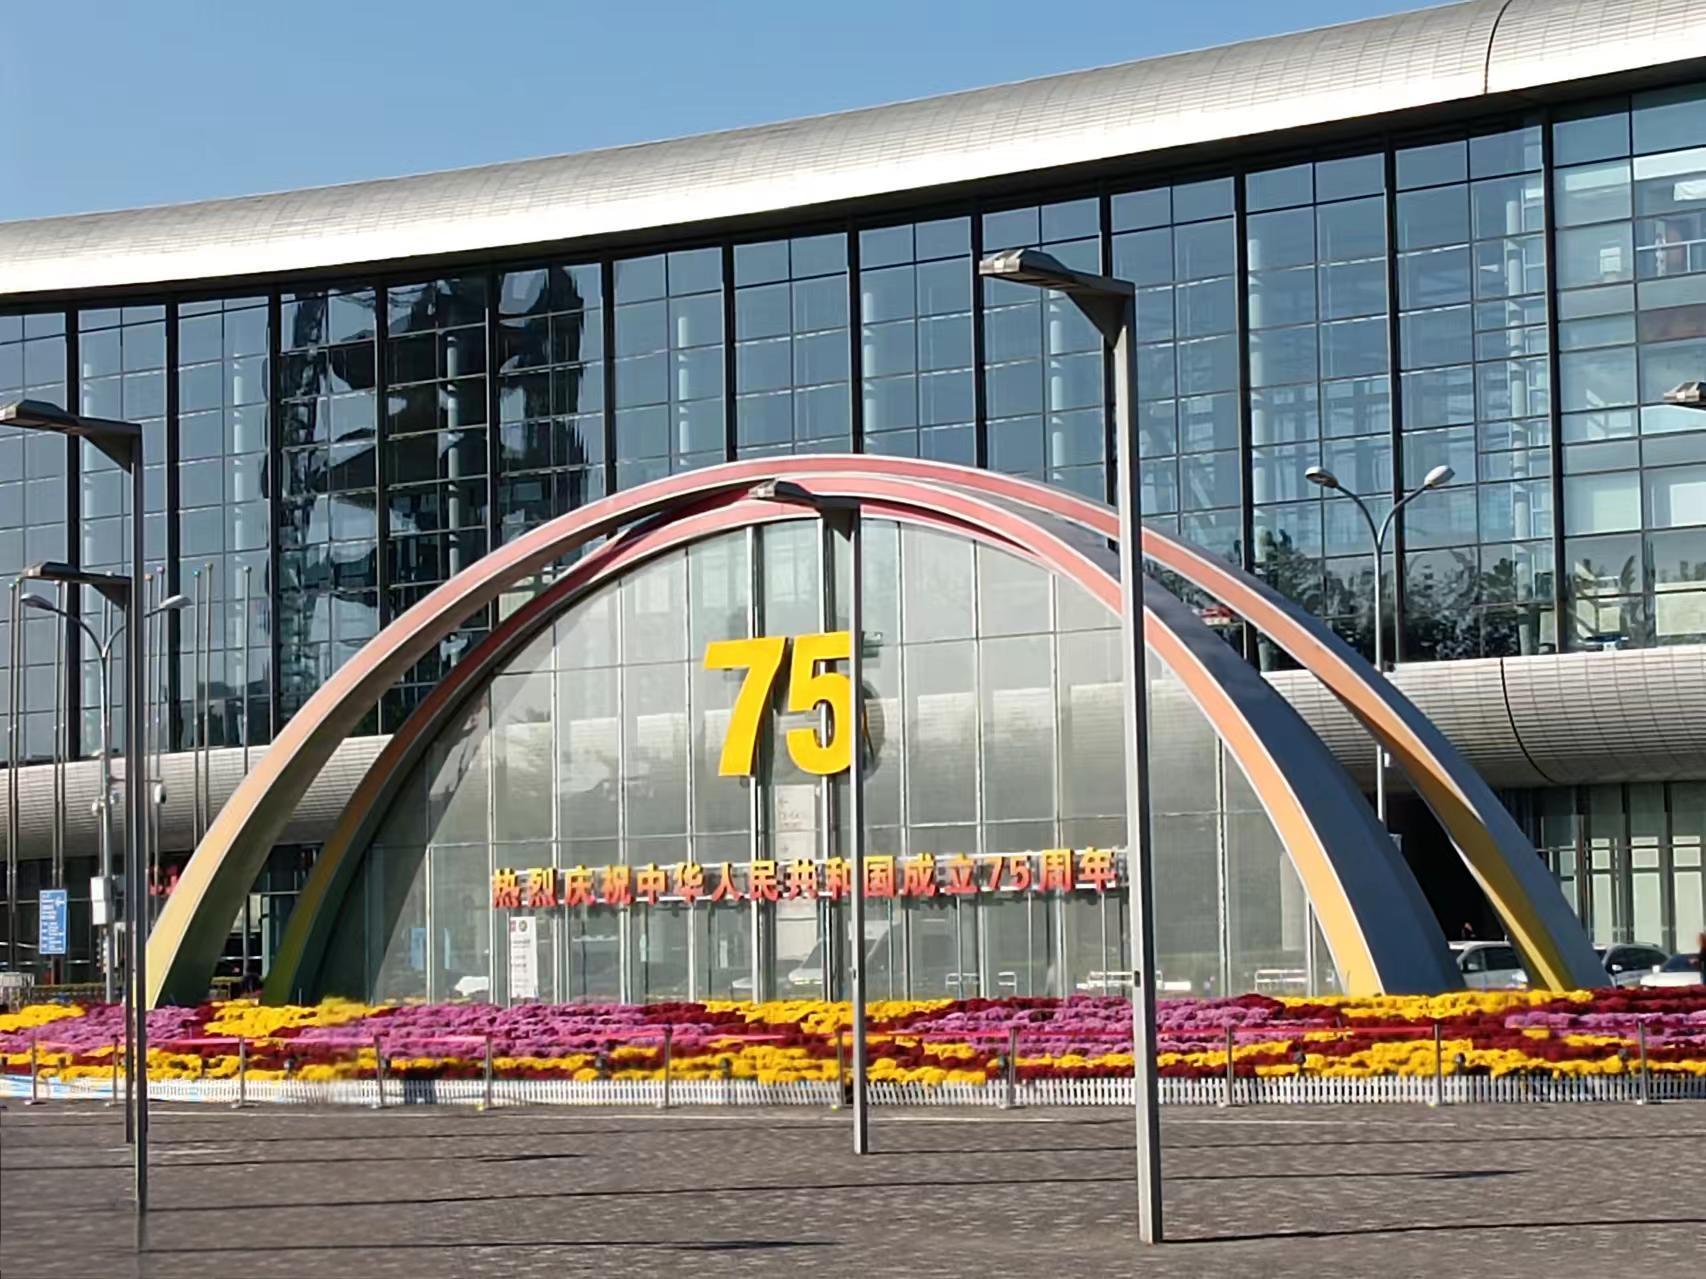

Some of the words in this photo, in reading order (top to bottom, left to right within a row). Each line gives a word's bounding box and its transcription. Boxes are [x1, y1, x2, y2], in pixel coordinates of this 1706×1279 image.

[703, 631, 857, 777] 75
[493, 847, 1118, 908] 热烈庆祝中华人民共和国成立75周年
